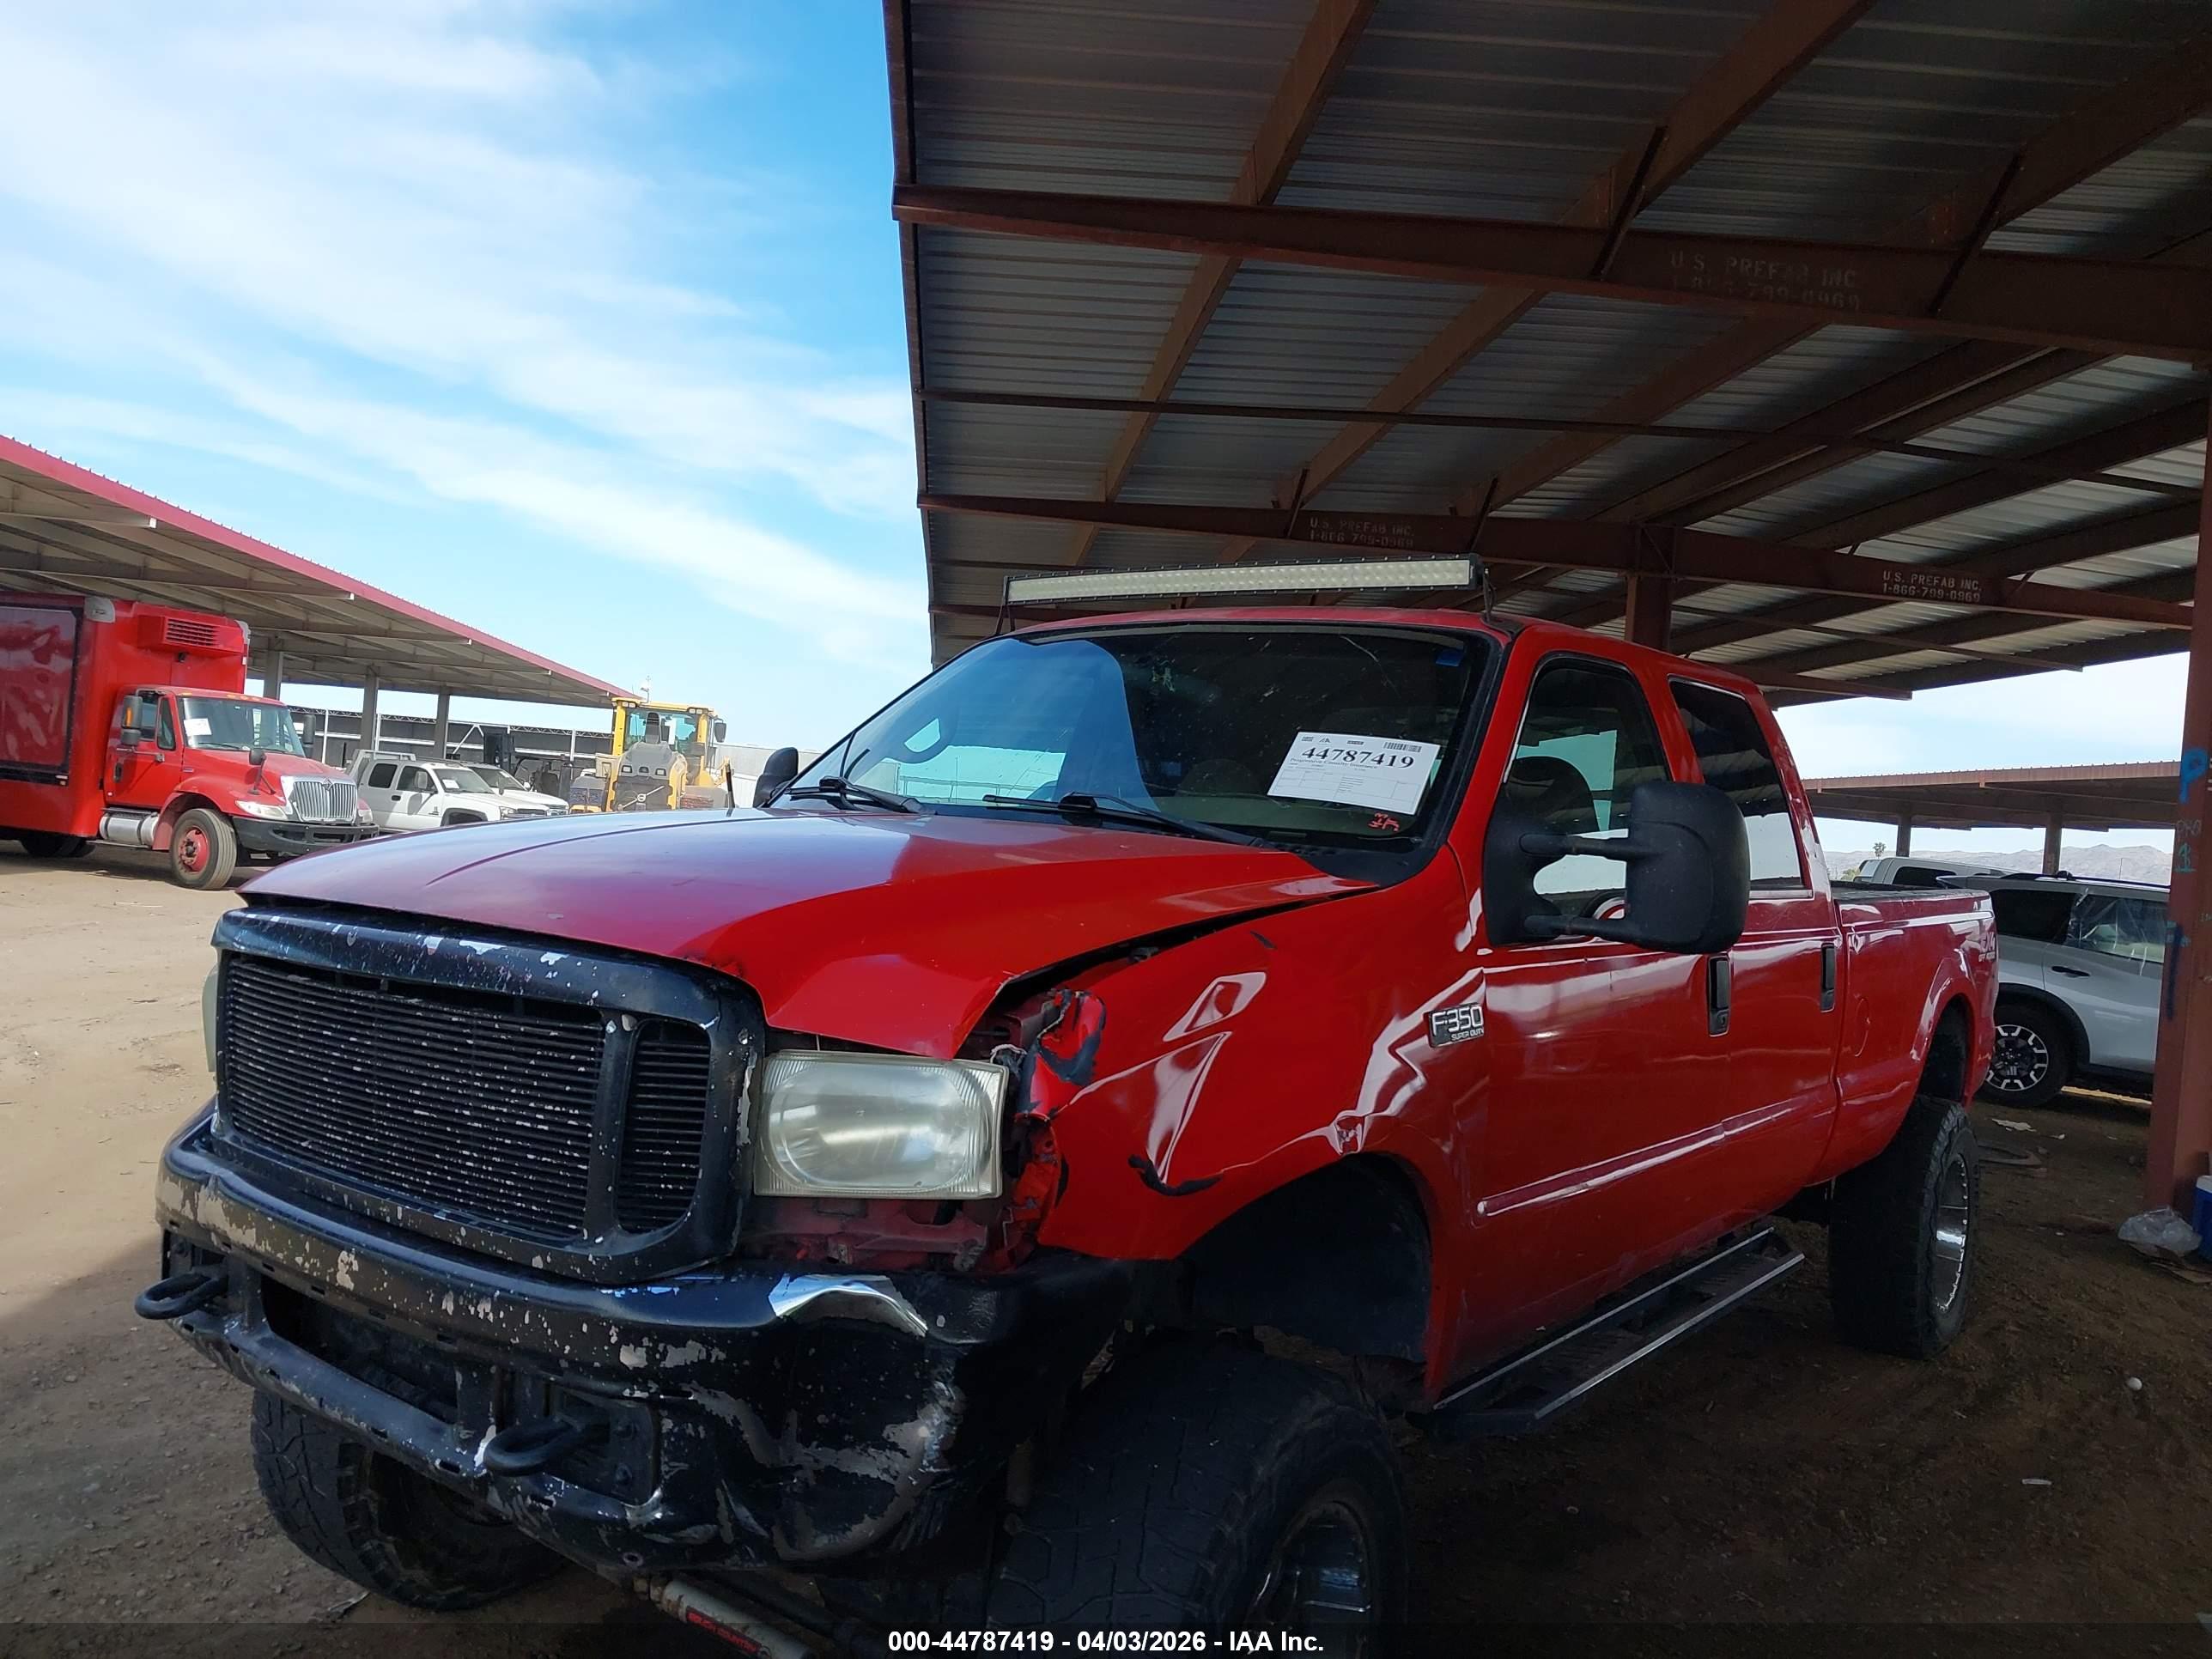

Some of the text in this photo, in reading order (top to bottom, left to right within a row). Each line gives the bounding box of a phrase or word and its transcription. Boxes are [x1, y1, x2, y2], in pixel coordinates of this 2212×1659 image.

[1911, 574, 1955, 588] PREFAB
[1960, 578, 1983, 592] INC.
[1302, 746, 1414, 769] 44787419
[1451, 1028, 1485, 1041] SUPER DUTY
